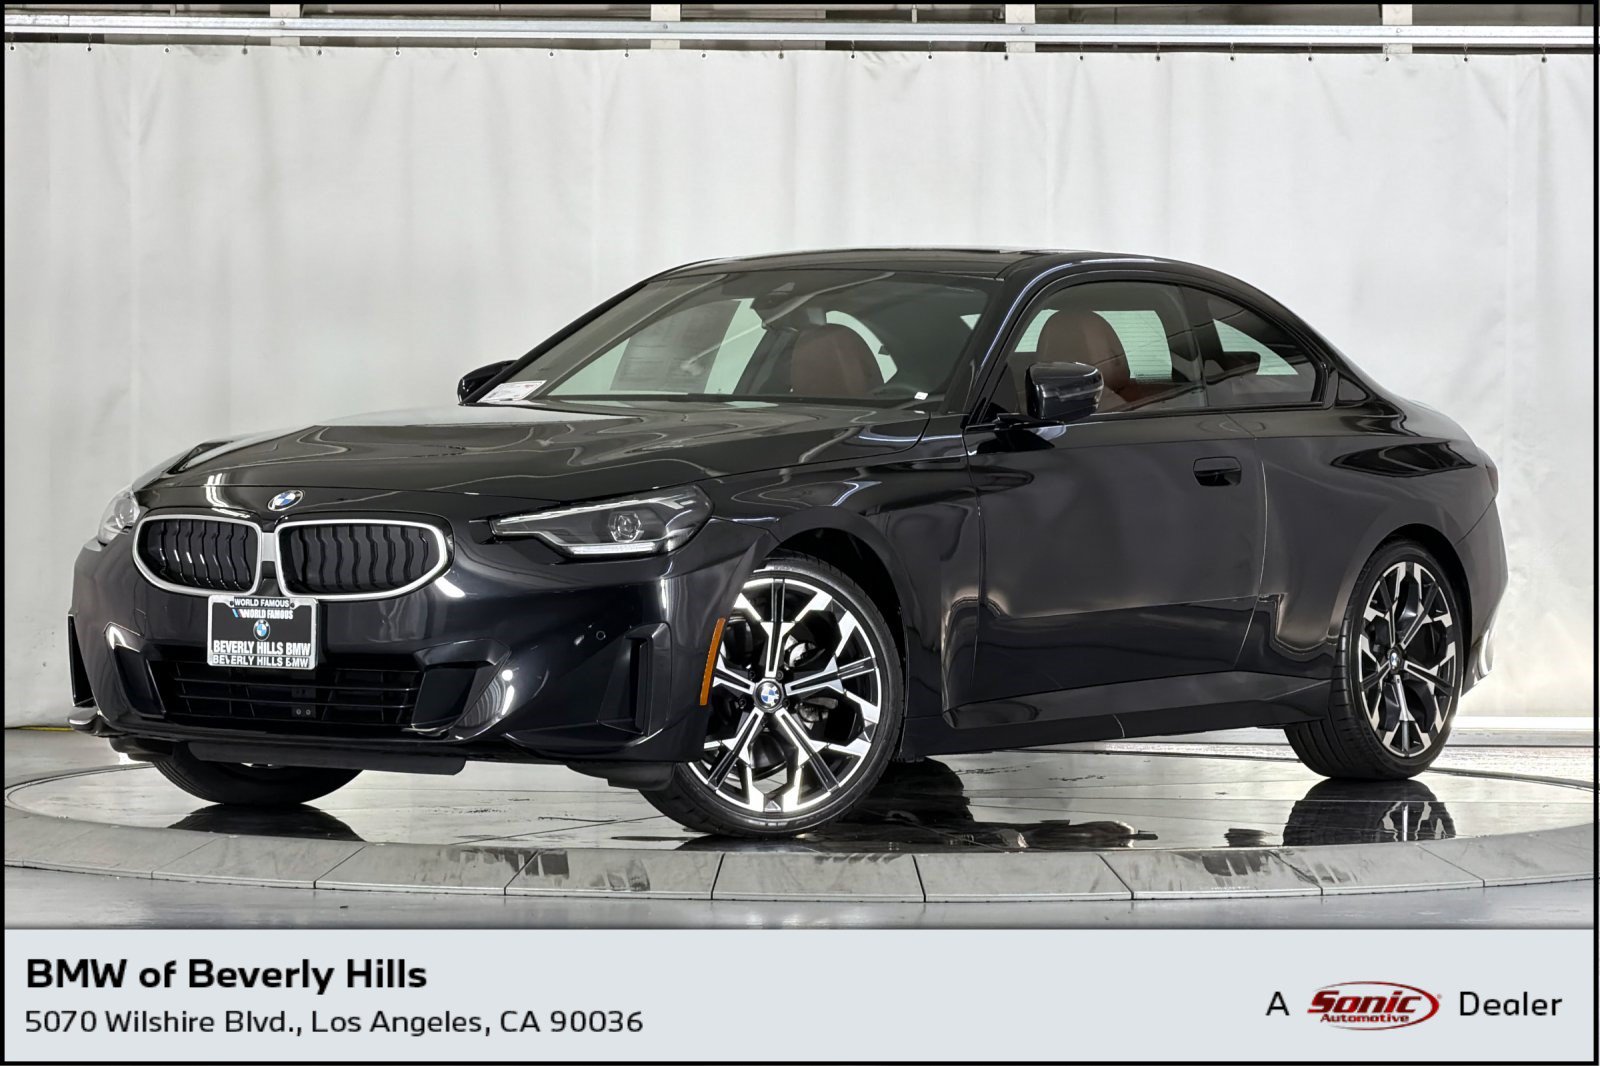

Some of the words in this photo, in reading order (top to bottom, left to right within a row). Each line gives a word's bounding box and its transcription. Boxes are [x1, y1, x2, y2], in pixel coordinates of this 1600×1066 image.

[234, 599, 259, 607] WORLD
[260, 600, 290, 608] FAMOUS
[239, 609, 266, 618] WORLD
[267, 609, 294, 619] FAMOUS
[213, 640, 254, 654] BEVERLY
[256, 641, 283, 655] HILLS
[285, 642, 311, 656] BMW
[213, 655, 254, 665] BEVERLY
[256, 656, 283, 666] HILLS
